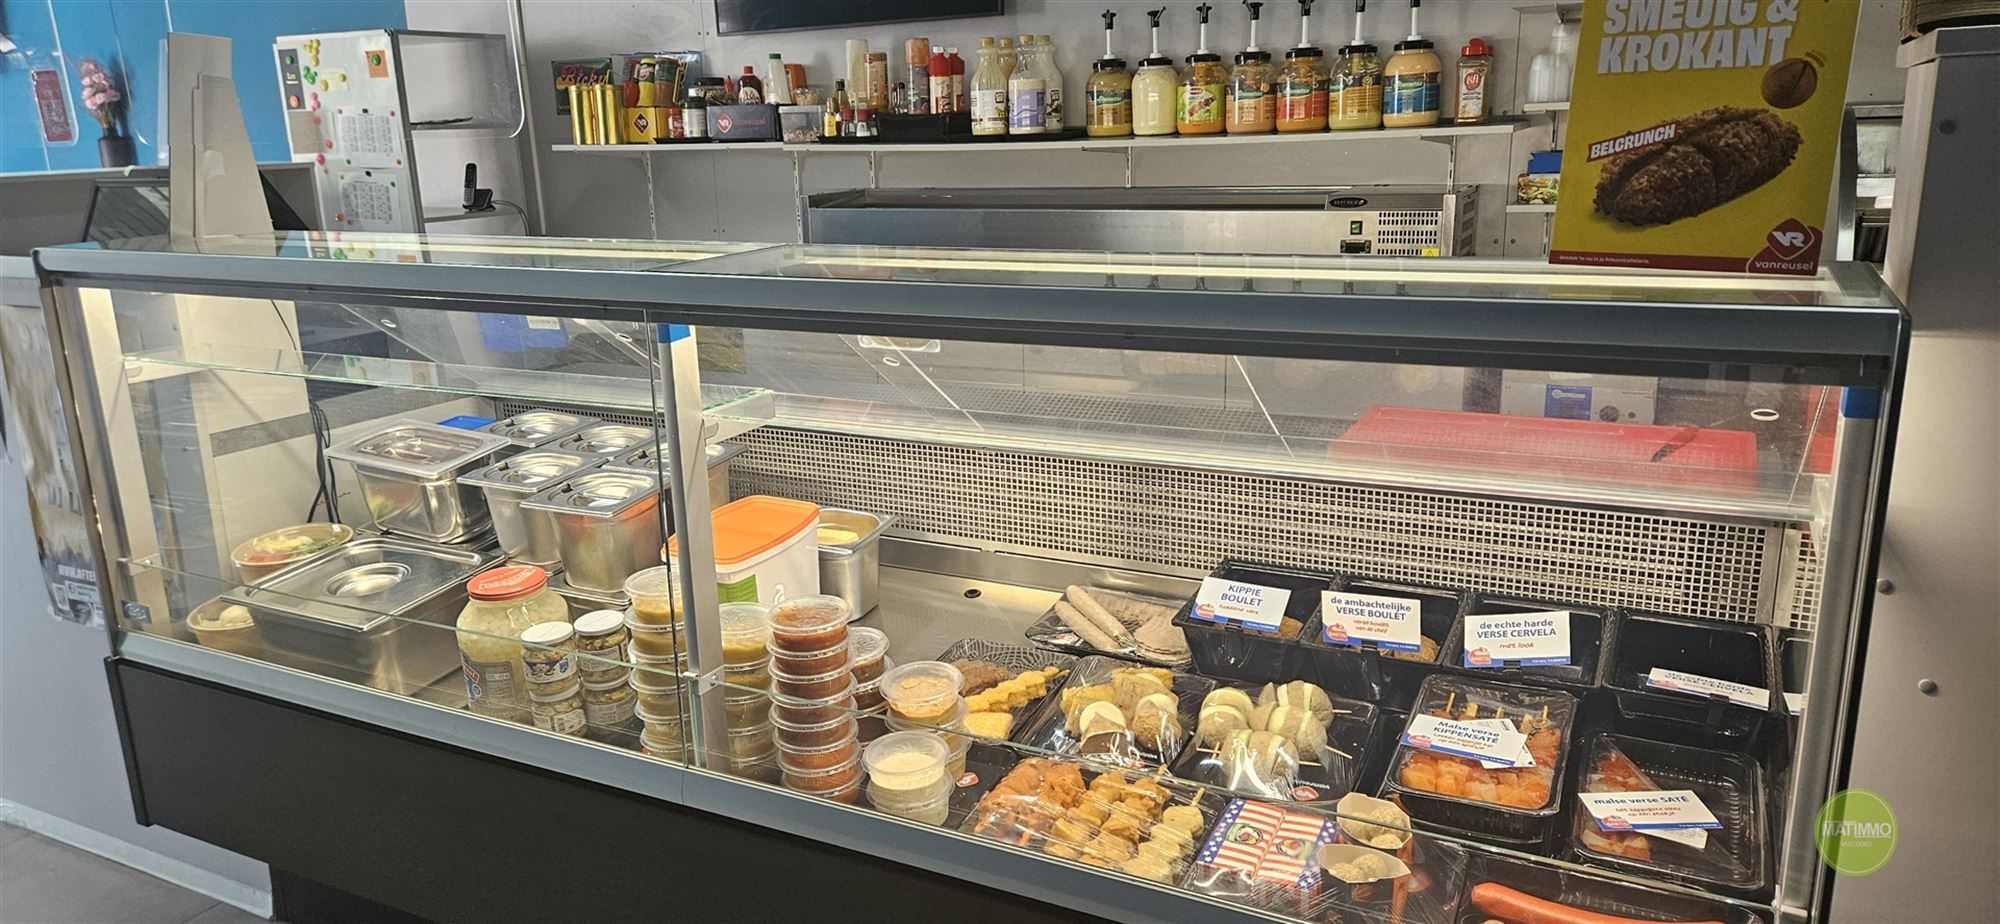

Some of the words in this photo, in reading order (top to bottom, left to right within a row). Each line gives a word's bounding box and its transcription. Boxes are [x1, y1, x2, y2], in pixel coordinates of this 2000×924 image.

[1766, 0, 1798, 23] &
[1597, 25, 1793, 75] KROKANT
[1590, 124, 1676, 159] BELCRUNCH
[1771, 231, 1804, 247] VR
[1755, 261, 1813, 270] vanreusel
[1228, 585, 1262, 596] KIPPIE
[1221, 593, 1263, 606] BOULET
[1344, 600, 1412, 612] ambachtelijke
[1336, 607, 1366, 616] VERSE
[1367, 610, 1406, 621] BOULET
[1494, 621, 1522, 629] echte
[1524, 619, 1554, 628] harde
[1477, 630, 1508, 638] VERSE
[1510, 628, 1557, 637] CERVELA
[1438, 721, 1469, 732] Malse
[1470, 728, 1500, 737] verse
